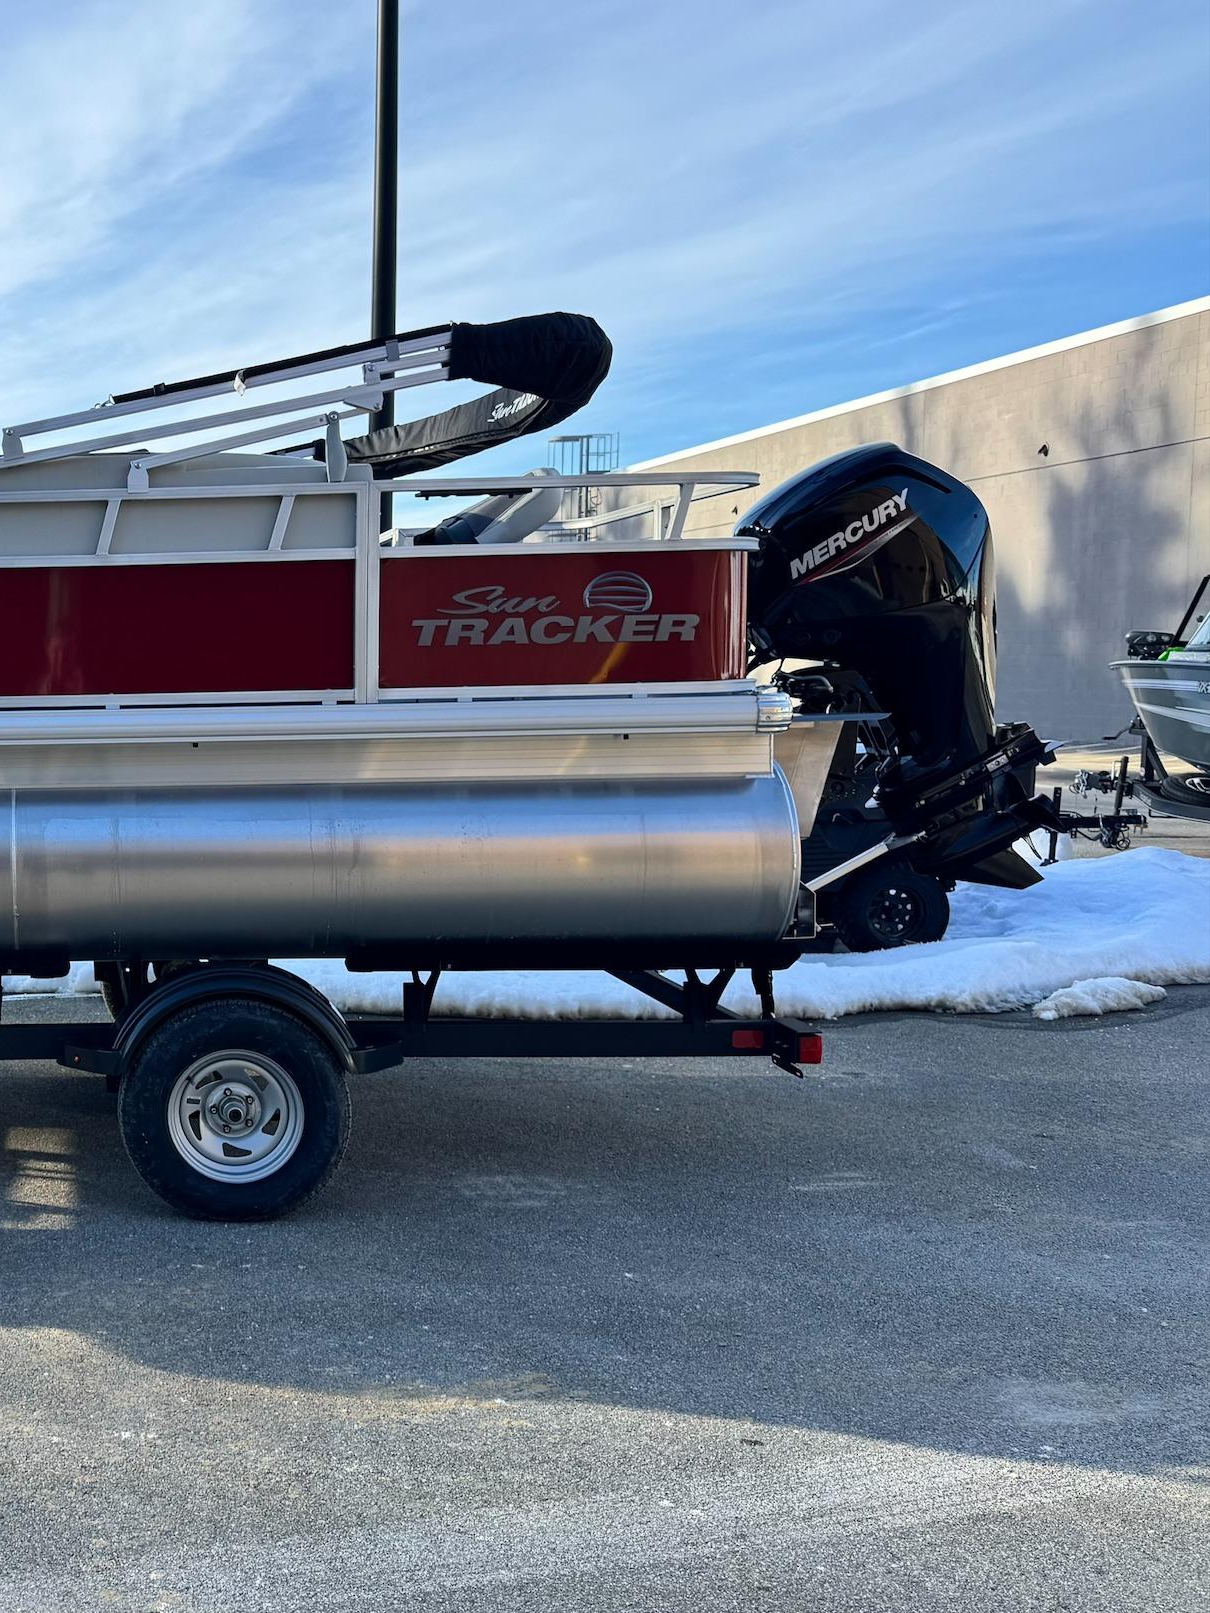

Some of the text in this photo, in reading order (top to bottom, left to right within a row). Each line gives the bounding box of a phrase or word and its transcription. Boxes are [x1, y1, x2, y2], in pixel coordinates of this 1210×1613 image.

[790, 488, 909, 579] MERCURY
[436, 585, 561, 614] Sun
[411, 613, 700, 646] TRACKER
